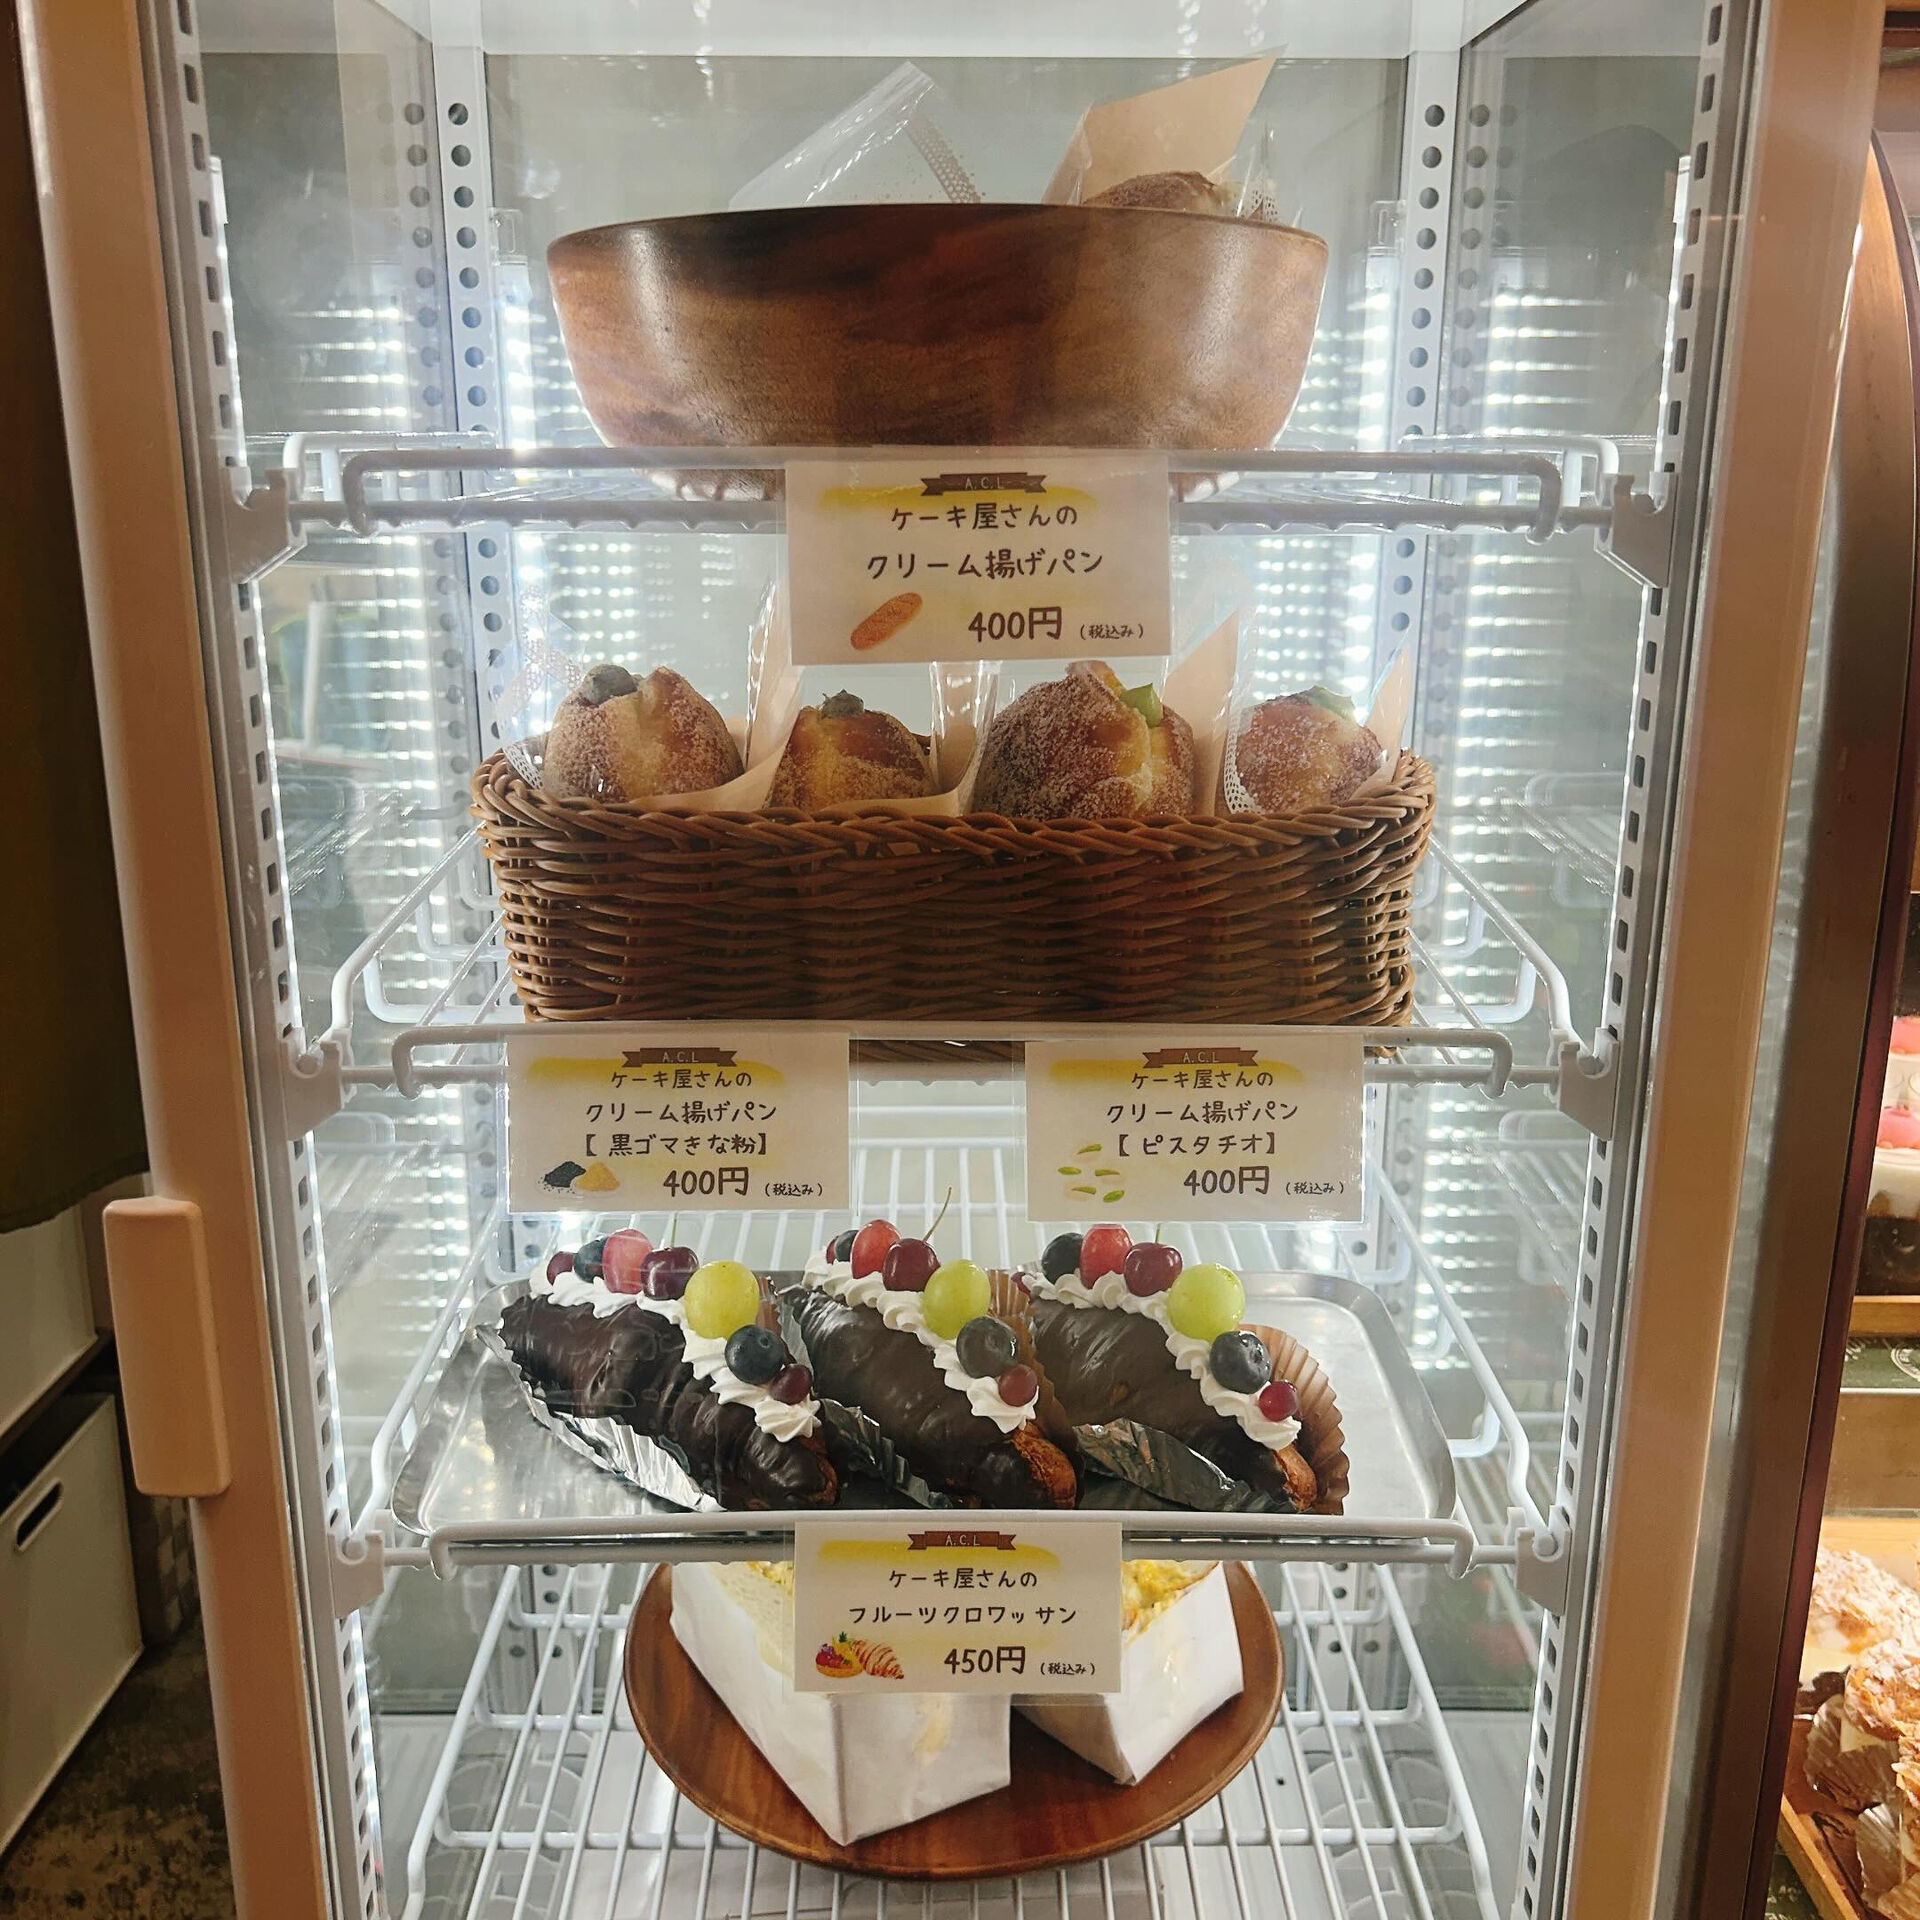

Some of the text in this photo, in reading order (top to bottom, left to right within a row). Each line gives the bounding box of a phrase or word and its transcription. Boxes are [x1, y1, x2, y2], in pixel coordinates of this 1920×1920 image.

[891, 502, 1078, 530] ケーキ屋さんの
[867, 548, 1103, 579] クリーム揚げパン
[968, 606, 1144, 642] 400円 （税込み）
[611, 1069, 752, 1089] ケーキ屋さんの
[1131, 1069, 1274, 1089] ケーキ屋さんの
[585, 1101, 777, 1124] クリーム揚げパン
[1106, 1101, 1298, 1123] クリーム揚げパン
[586, 1133, 767, 1157] 【黒ゴマきな粉】
[1119, 1132, 1275, 1157] 【ピスタチオ】
[663, 1166, 823, 1197] 400円 （税込み）
[1183, 1166, 1344, 1195] 400円 （税込み）
[889, 1567, 1038, 1589] ケーキ屋さんの
[849, 1606, 1076, 1624] フルーツクロワッサン
[944, 1646, 1095, 1676] 450円 （税込み）
